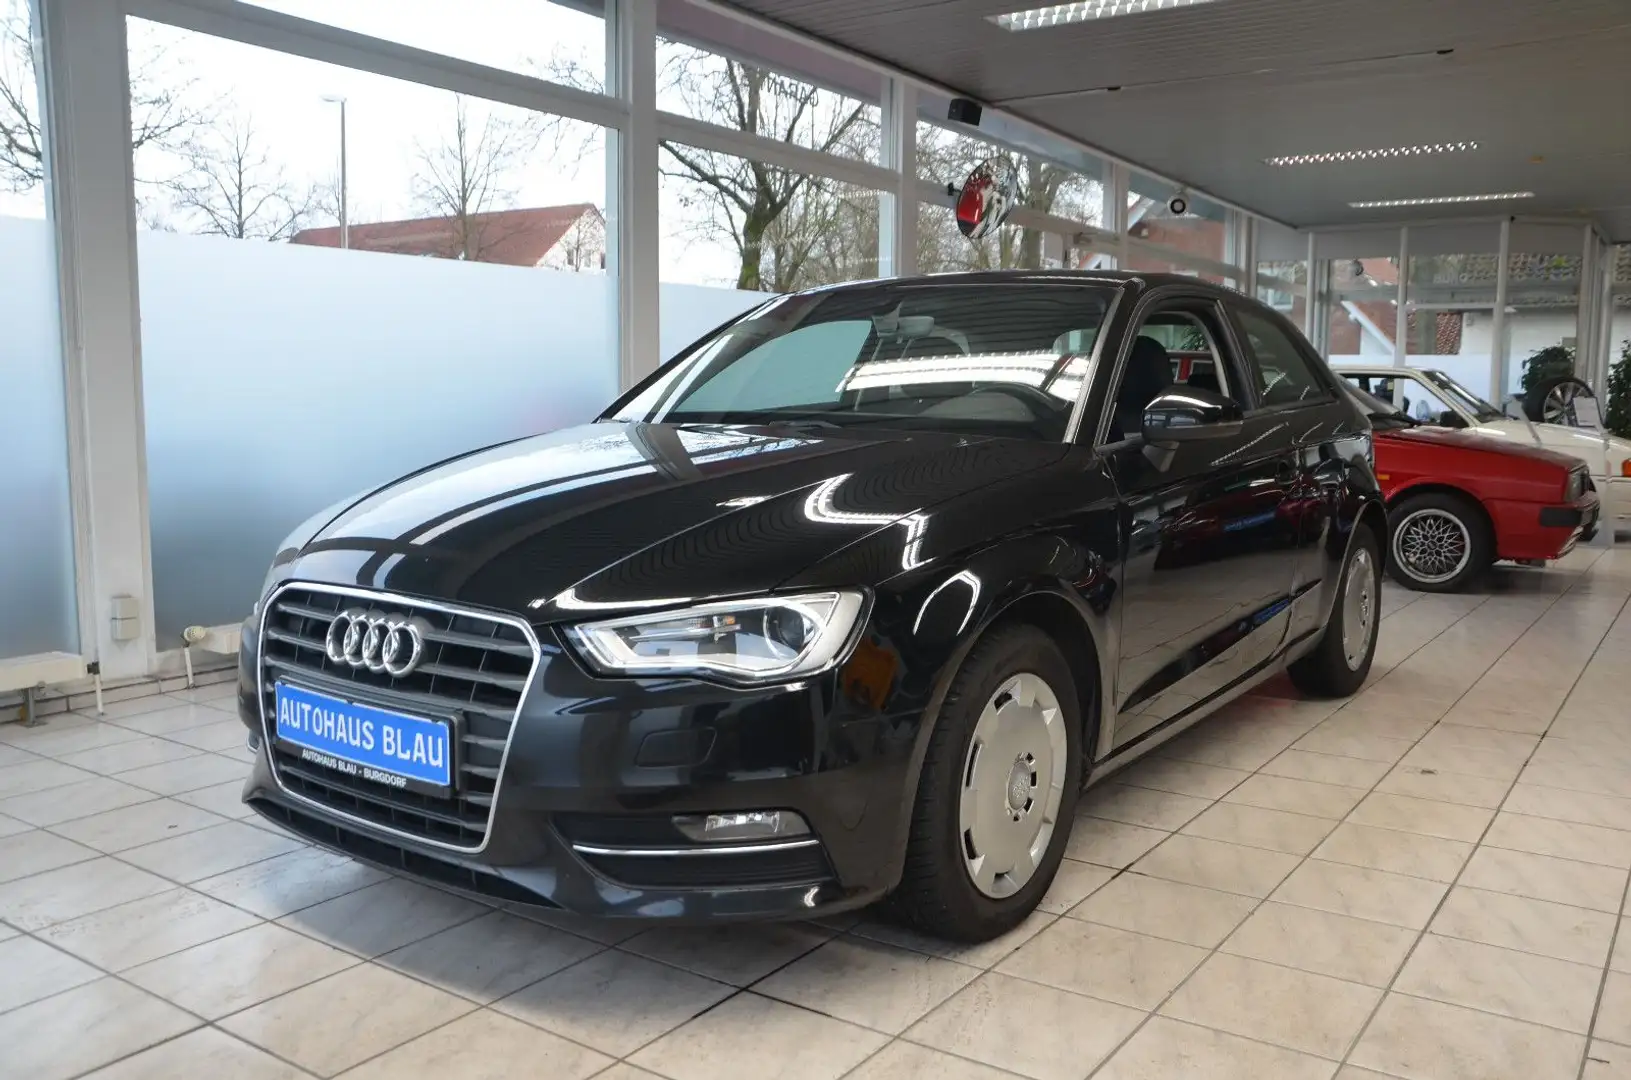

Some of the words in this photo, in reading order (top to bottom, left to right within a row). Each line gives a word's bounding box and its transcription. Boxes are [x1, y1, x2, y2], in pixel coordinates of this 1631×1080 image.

[280, 697, 375, 750] AUTOHAUS
[382, 724, 443, 768] BLAU
[302, 748, 337, 769] AUTOHAUS
[338, 759, 357, 775] BLAU
[363, 767, 407, 788] BURGDORF
